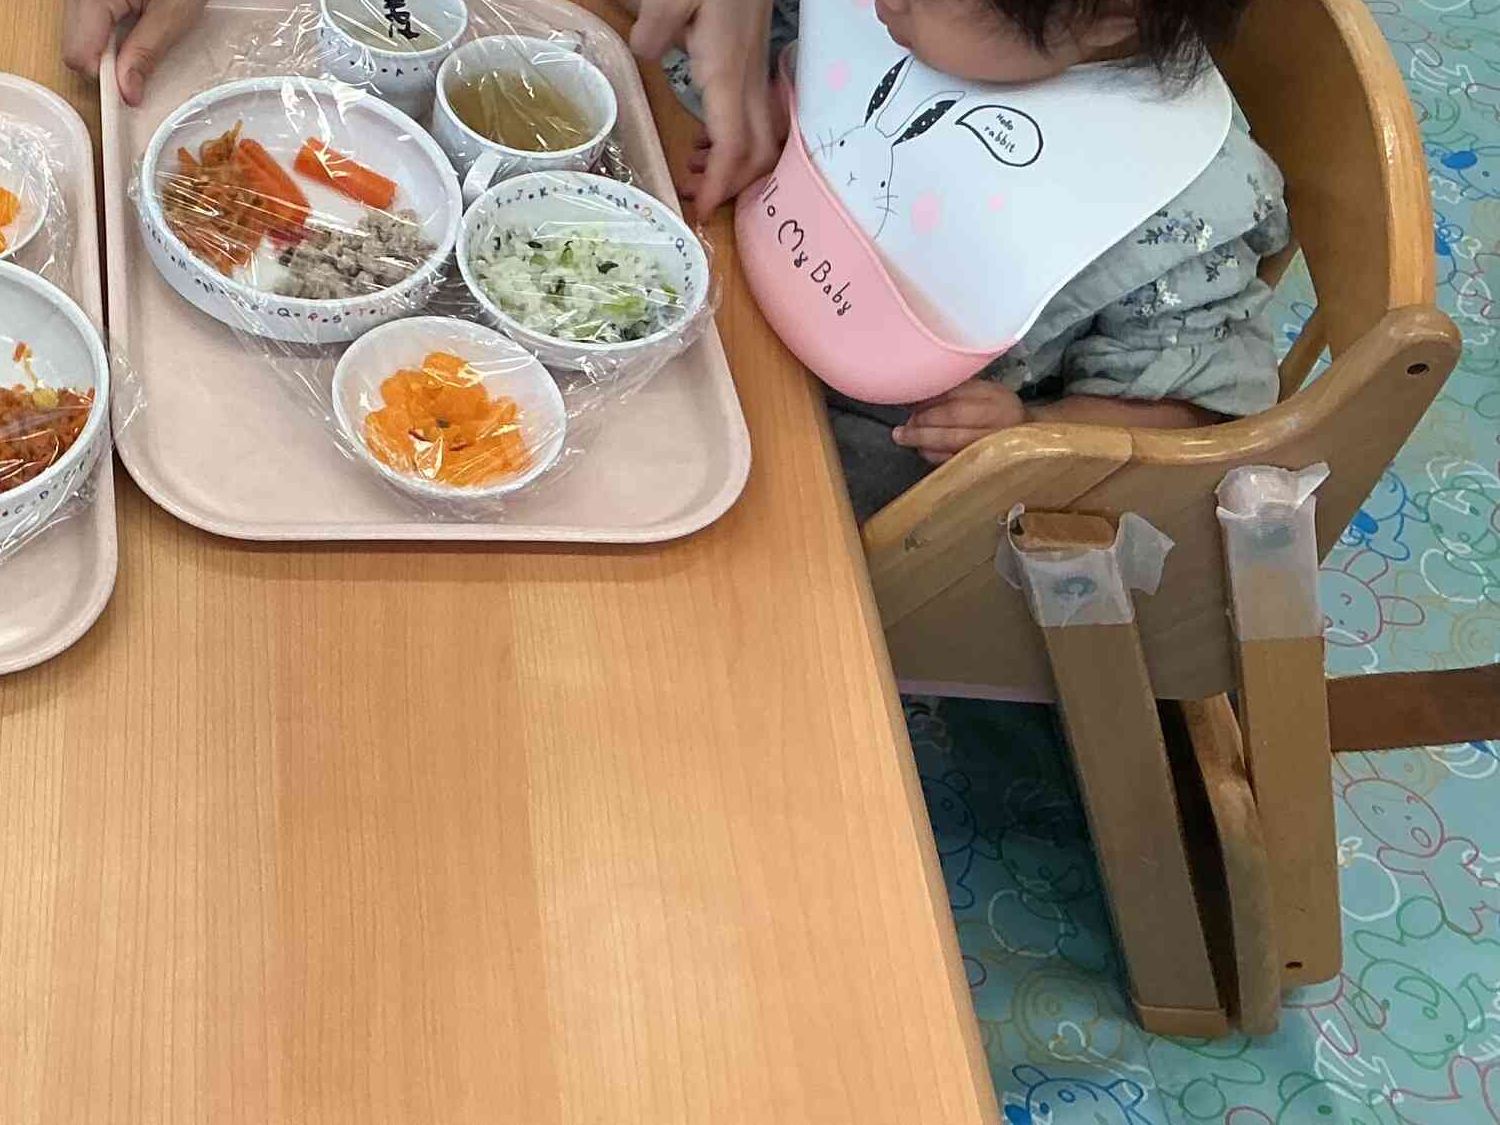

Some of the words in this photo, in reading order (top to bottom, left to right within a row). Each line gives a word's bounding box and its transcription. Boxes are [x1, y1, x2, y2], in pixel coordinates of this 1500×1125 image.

[984, 130, 1016, 153] rabbit
[778, 219, 809, 268] My
[810, 260, 852, 316] Baby
